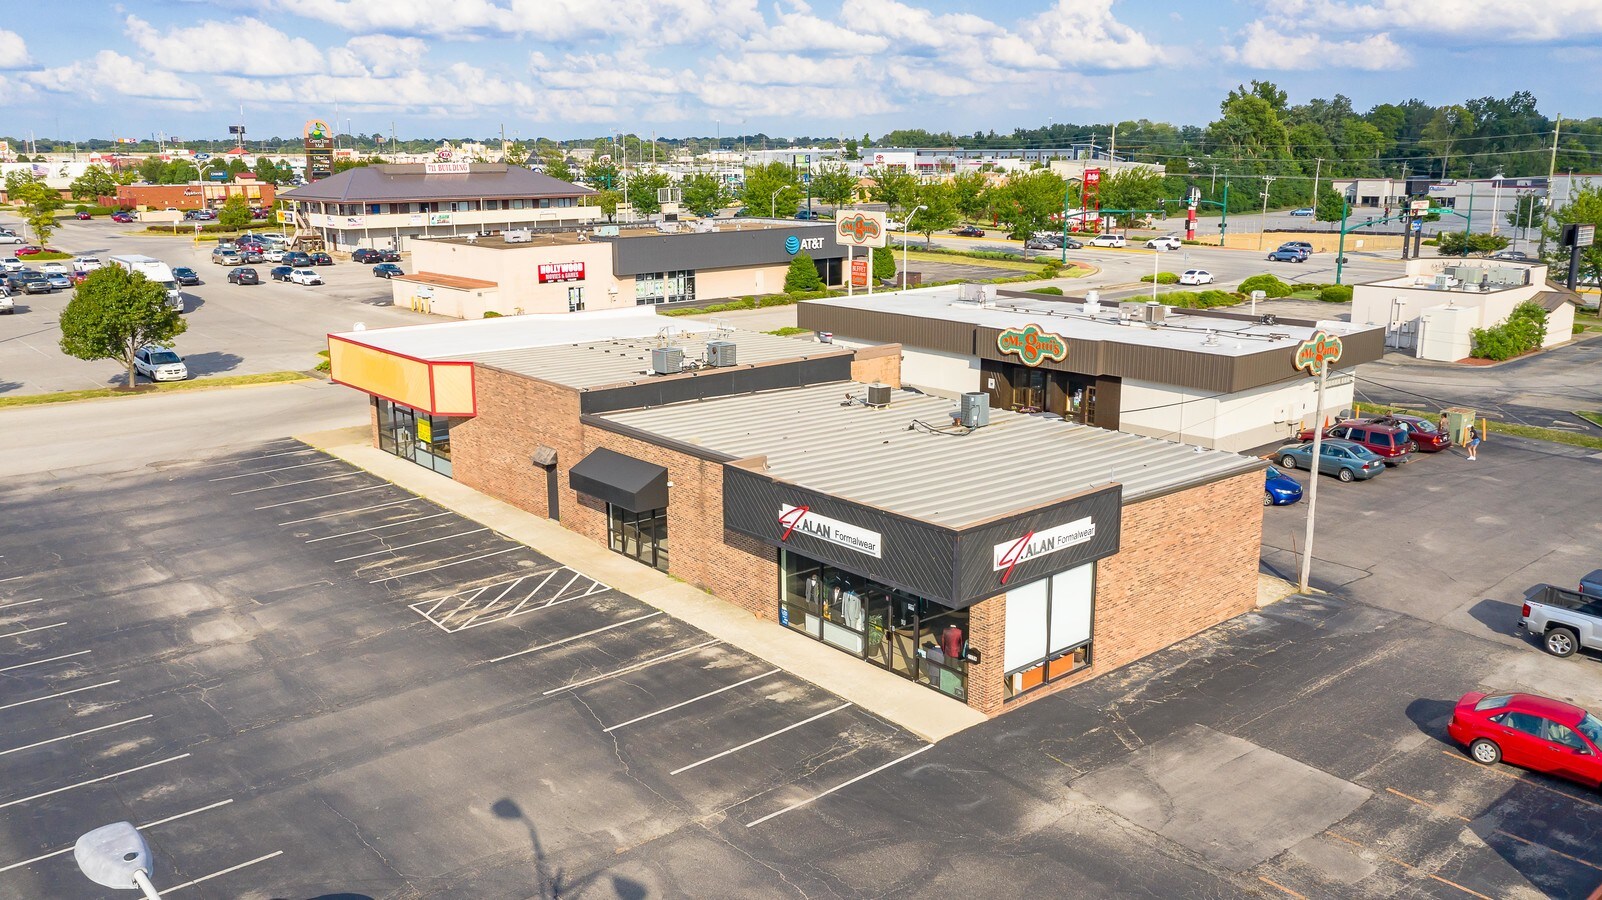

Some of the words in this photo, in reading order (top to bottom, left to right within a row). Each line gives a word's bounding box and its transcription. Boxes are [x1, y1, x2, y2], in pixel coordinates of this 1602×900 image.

[438, 163, 468, 172] BUILDING
[800, 237, 824, 250] AT&T
[540, 262, 583, 275] HOLLYWOOD
[1002, 335, 1023, 348] Mr.
[802, 518, 831, 539] ALAN
[834, 529, 876, 551] Formalwear
[1025, 536, 1055, 558] ALAN
[1057, 526, 1094, 546] Formalwear
